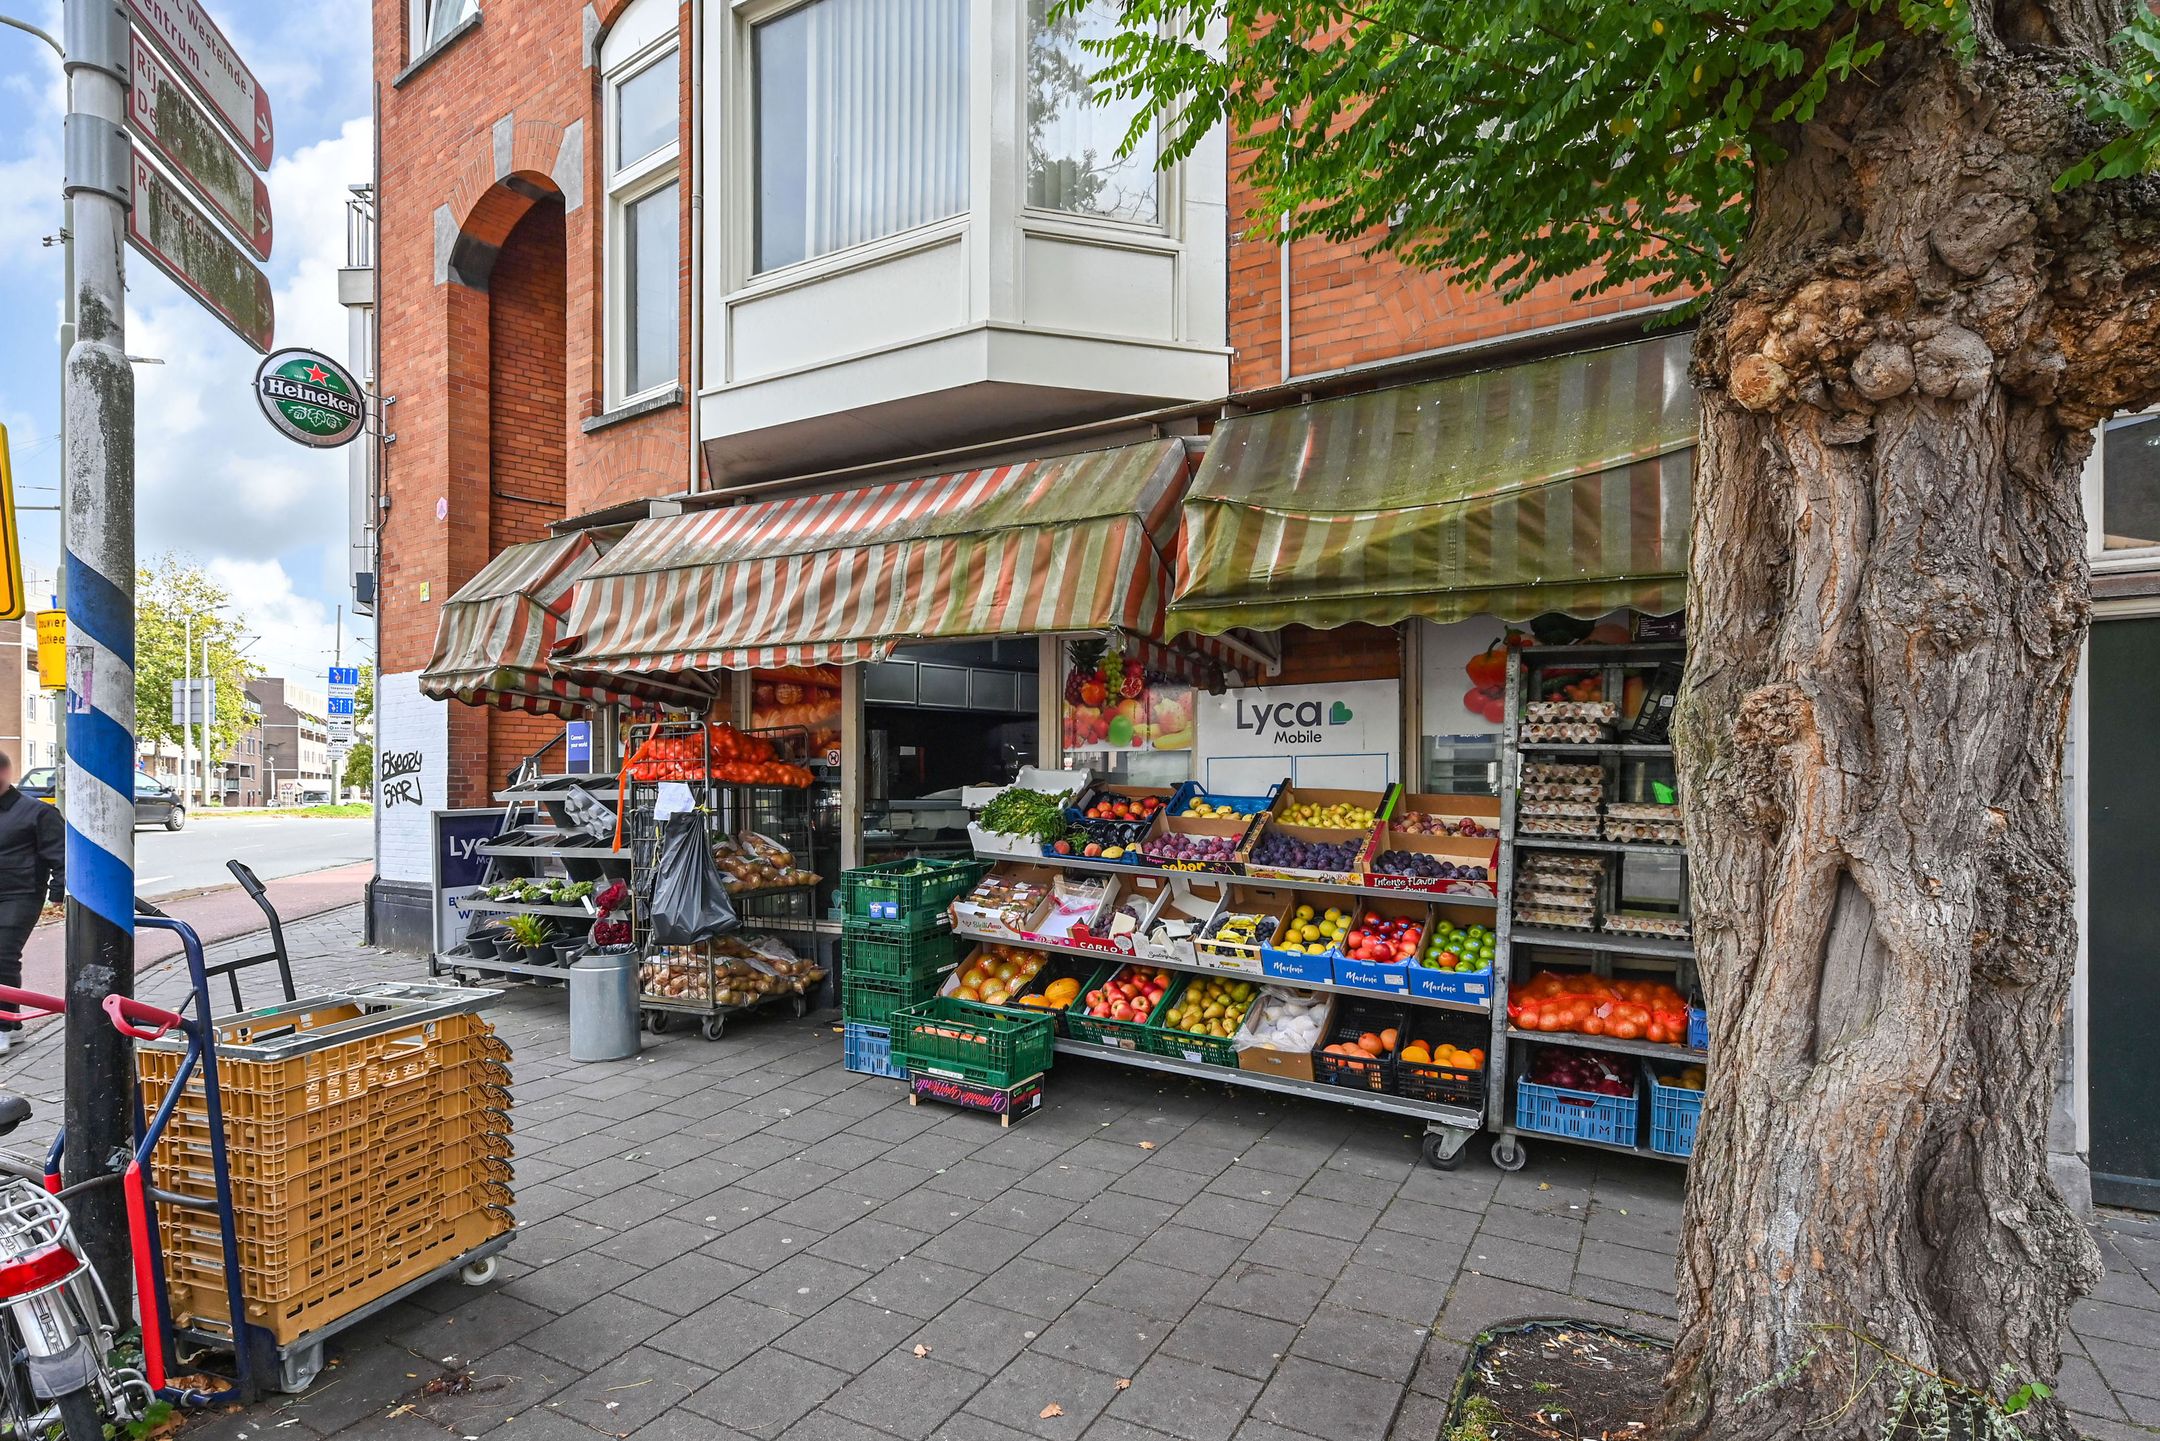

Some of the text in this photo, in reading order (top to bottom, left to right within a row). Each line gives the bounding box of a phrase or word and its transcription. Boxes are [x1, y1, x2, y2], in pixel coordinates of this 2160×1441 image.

[143, 0, 200, 71] entrum
[187, 3, 247, 95] Westeinde
[268, 378, 358, 416] Heineken
[1237, 699, 1322, 736] Lyca
[1273, 730, 1323, 744] Mobile
[1373, 876, 1438, 888] Intense Flavor
